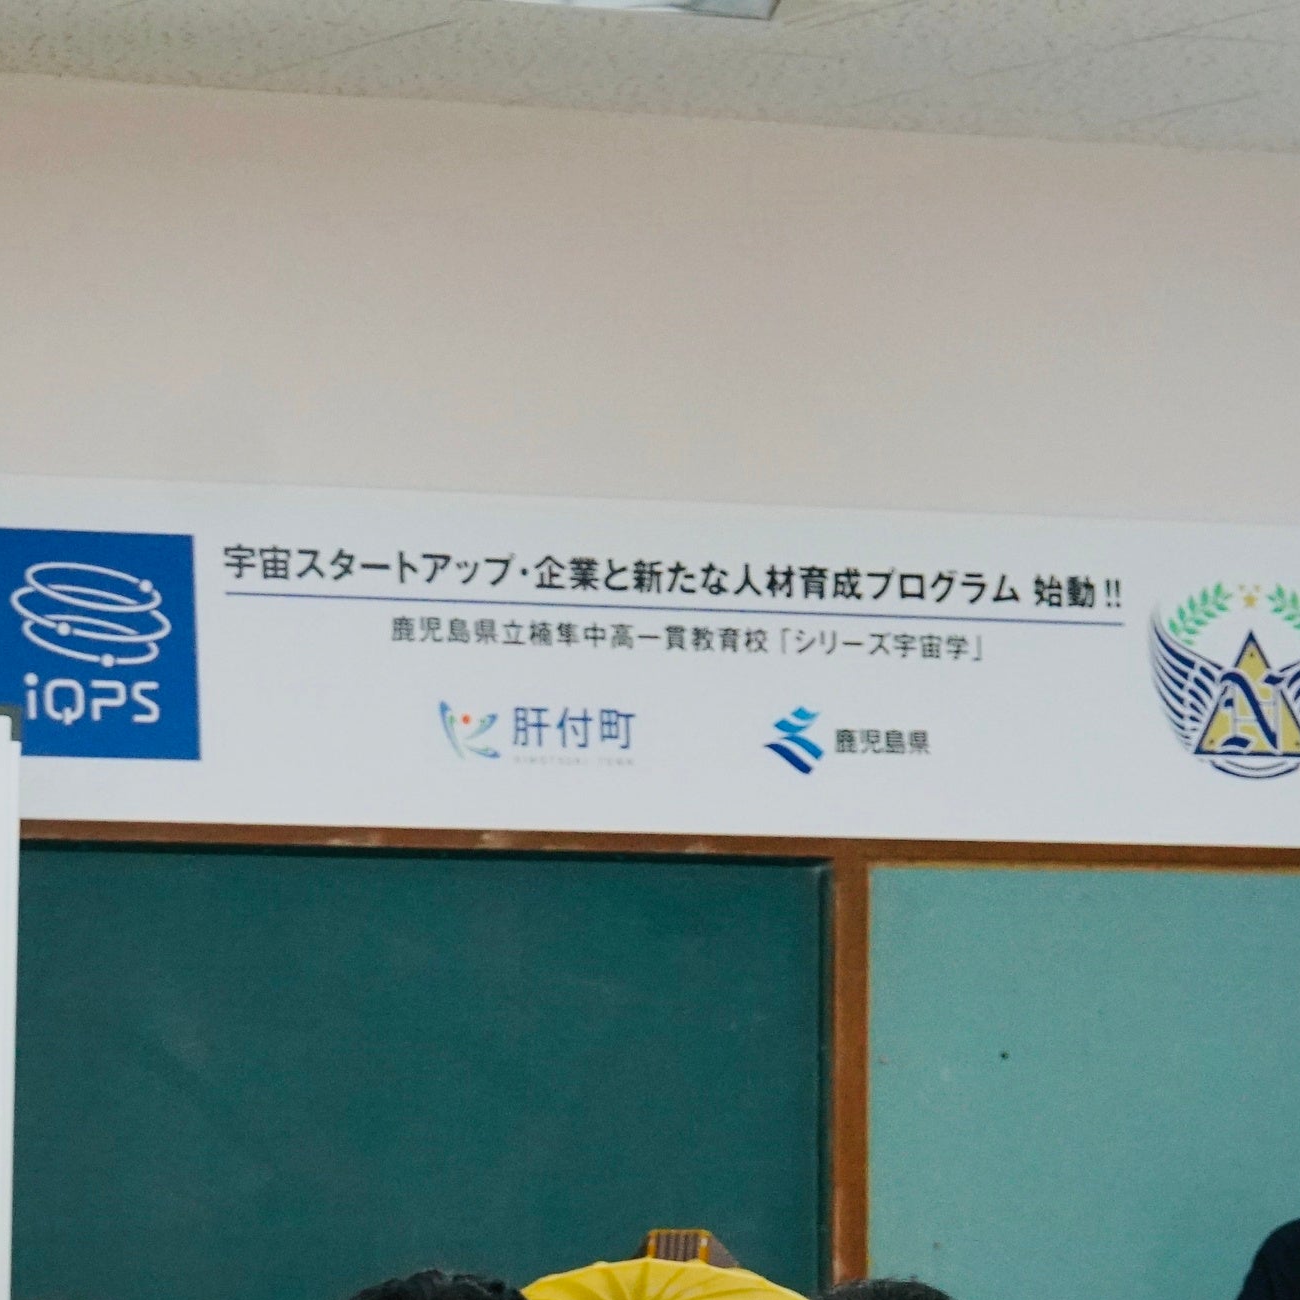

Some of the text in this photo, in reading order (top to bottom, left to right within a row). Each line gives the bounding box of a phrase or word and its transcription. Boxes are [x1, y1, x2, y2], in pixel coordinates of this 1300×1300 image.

[222, 544, 1021, 606] 宇宙スタートアップ・企業と新たな人材育成プログラム
[391, 615, 984, 662] 鹿児島県立楠隼中高一貫教育校「シリーズ宇宙学」
[22, 673, 161, 726] iQPS
[512, 706, 637, 750] 肝付町
[834, 729, 932, 756] 鹿児島県
